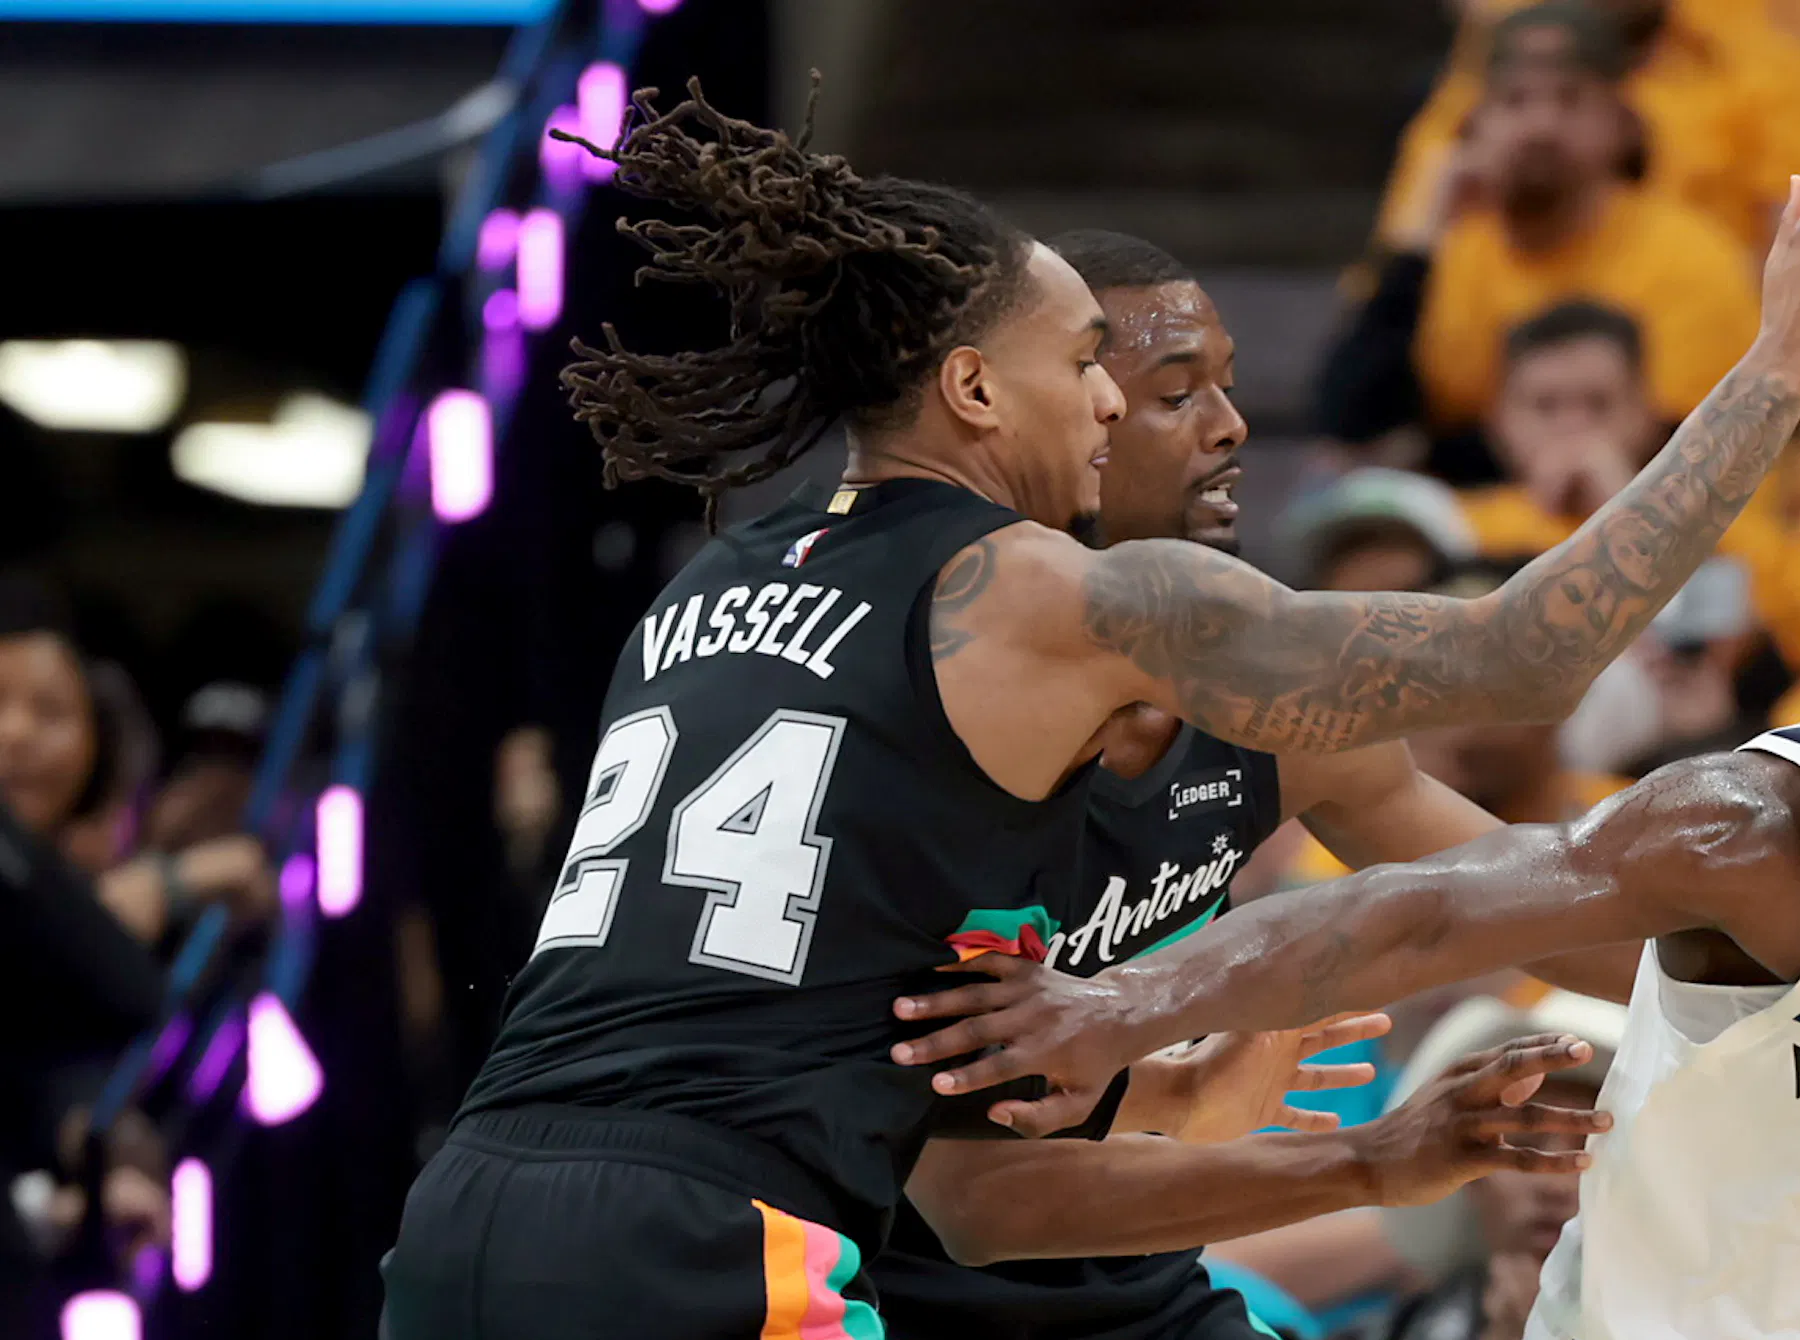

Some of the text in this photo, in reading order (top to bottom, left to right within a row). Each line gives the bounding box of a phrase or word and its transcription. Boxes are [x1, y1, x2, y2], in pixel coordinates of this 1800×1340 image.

[642, 582, 872, 682] VASSELL
[531, 705, 848, 987] 24
[1174, 781, 1231, 808] LEDGER
[1067, 848, 1243, 967] Antonio
